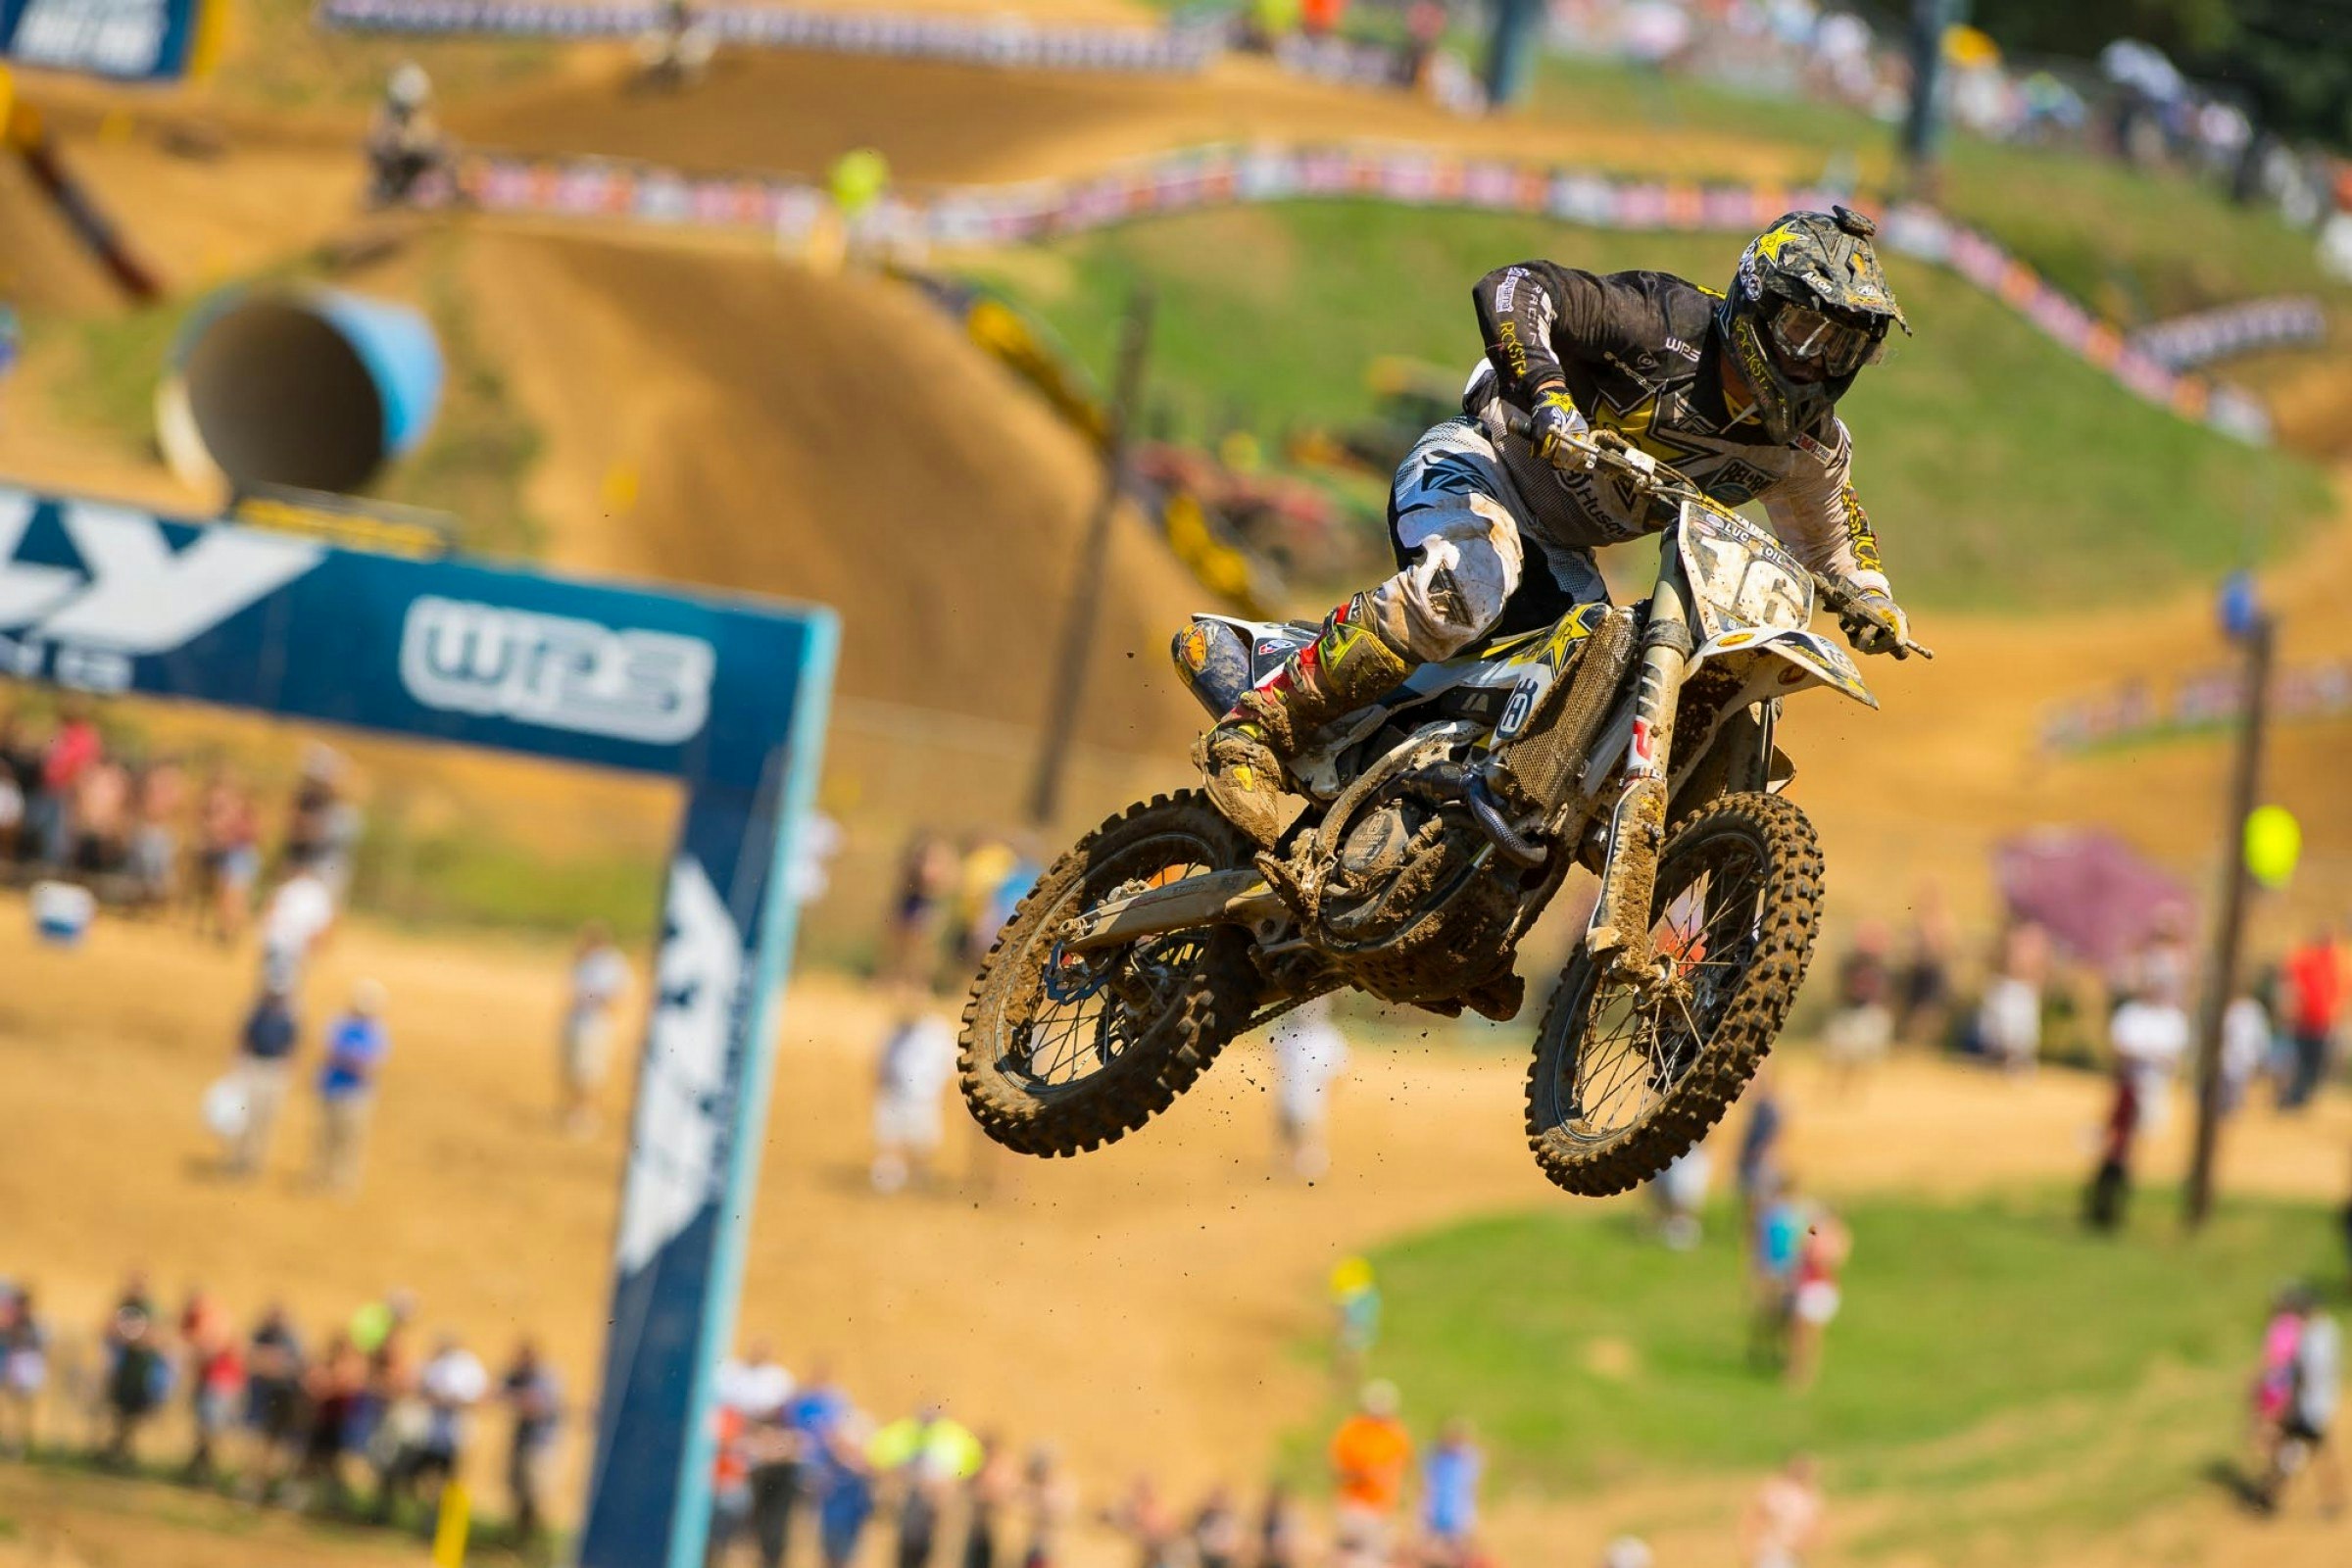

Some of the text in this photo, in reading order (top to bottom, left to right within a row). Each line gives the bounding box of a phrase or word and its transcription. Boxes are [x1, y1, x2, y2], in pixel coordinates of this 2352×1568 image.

[1666, 336, 1701, 363] WPS
[1765, 548, 1784, 564] OIL
[404, 600, 710, 742] WPS
